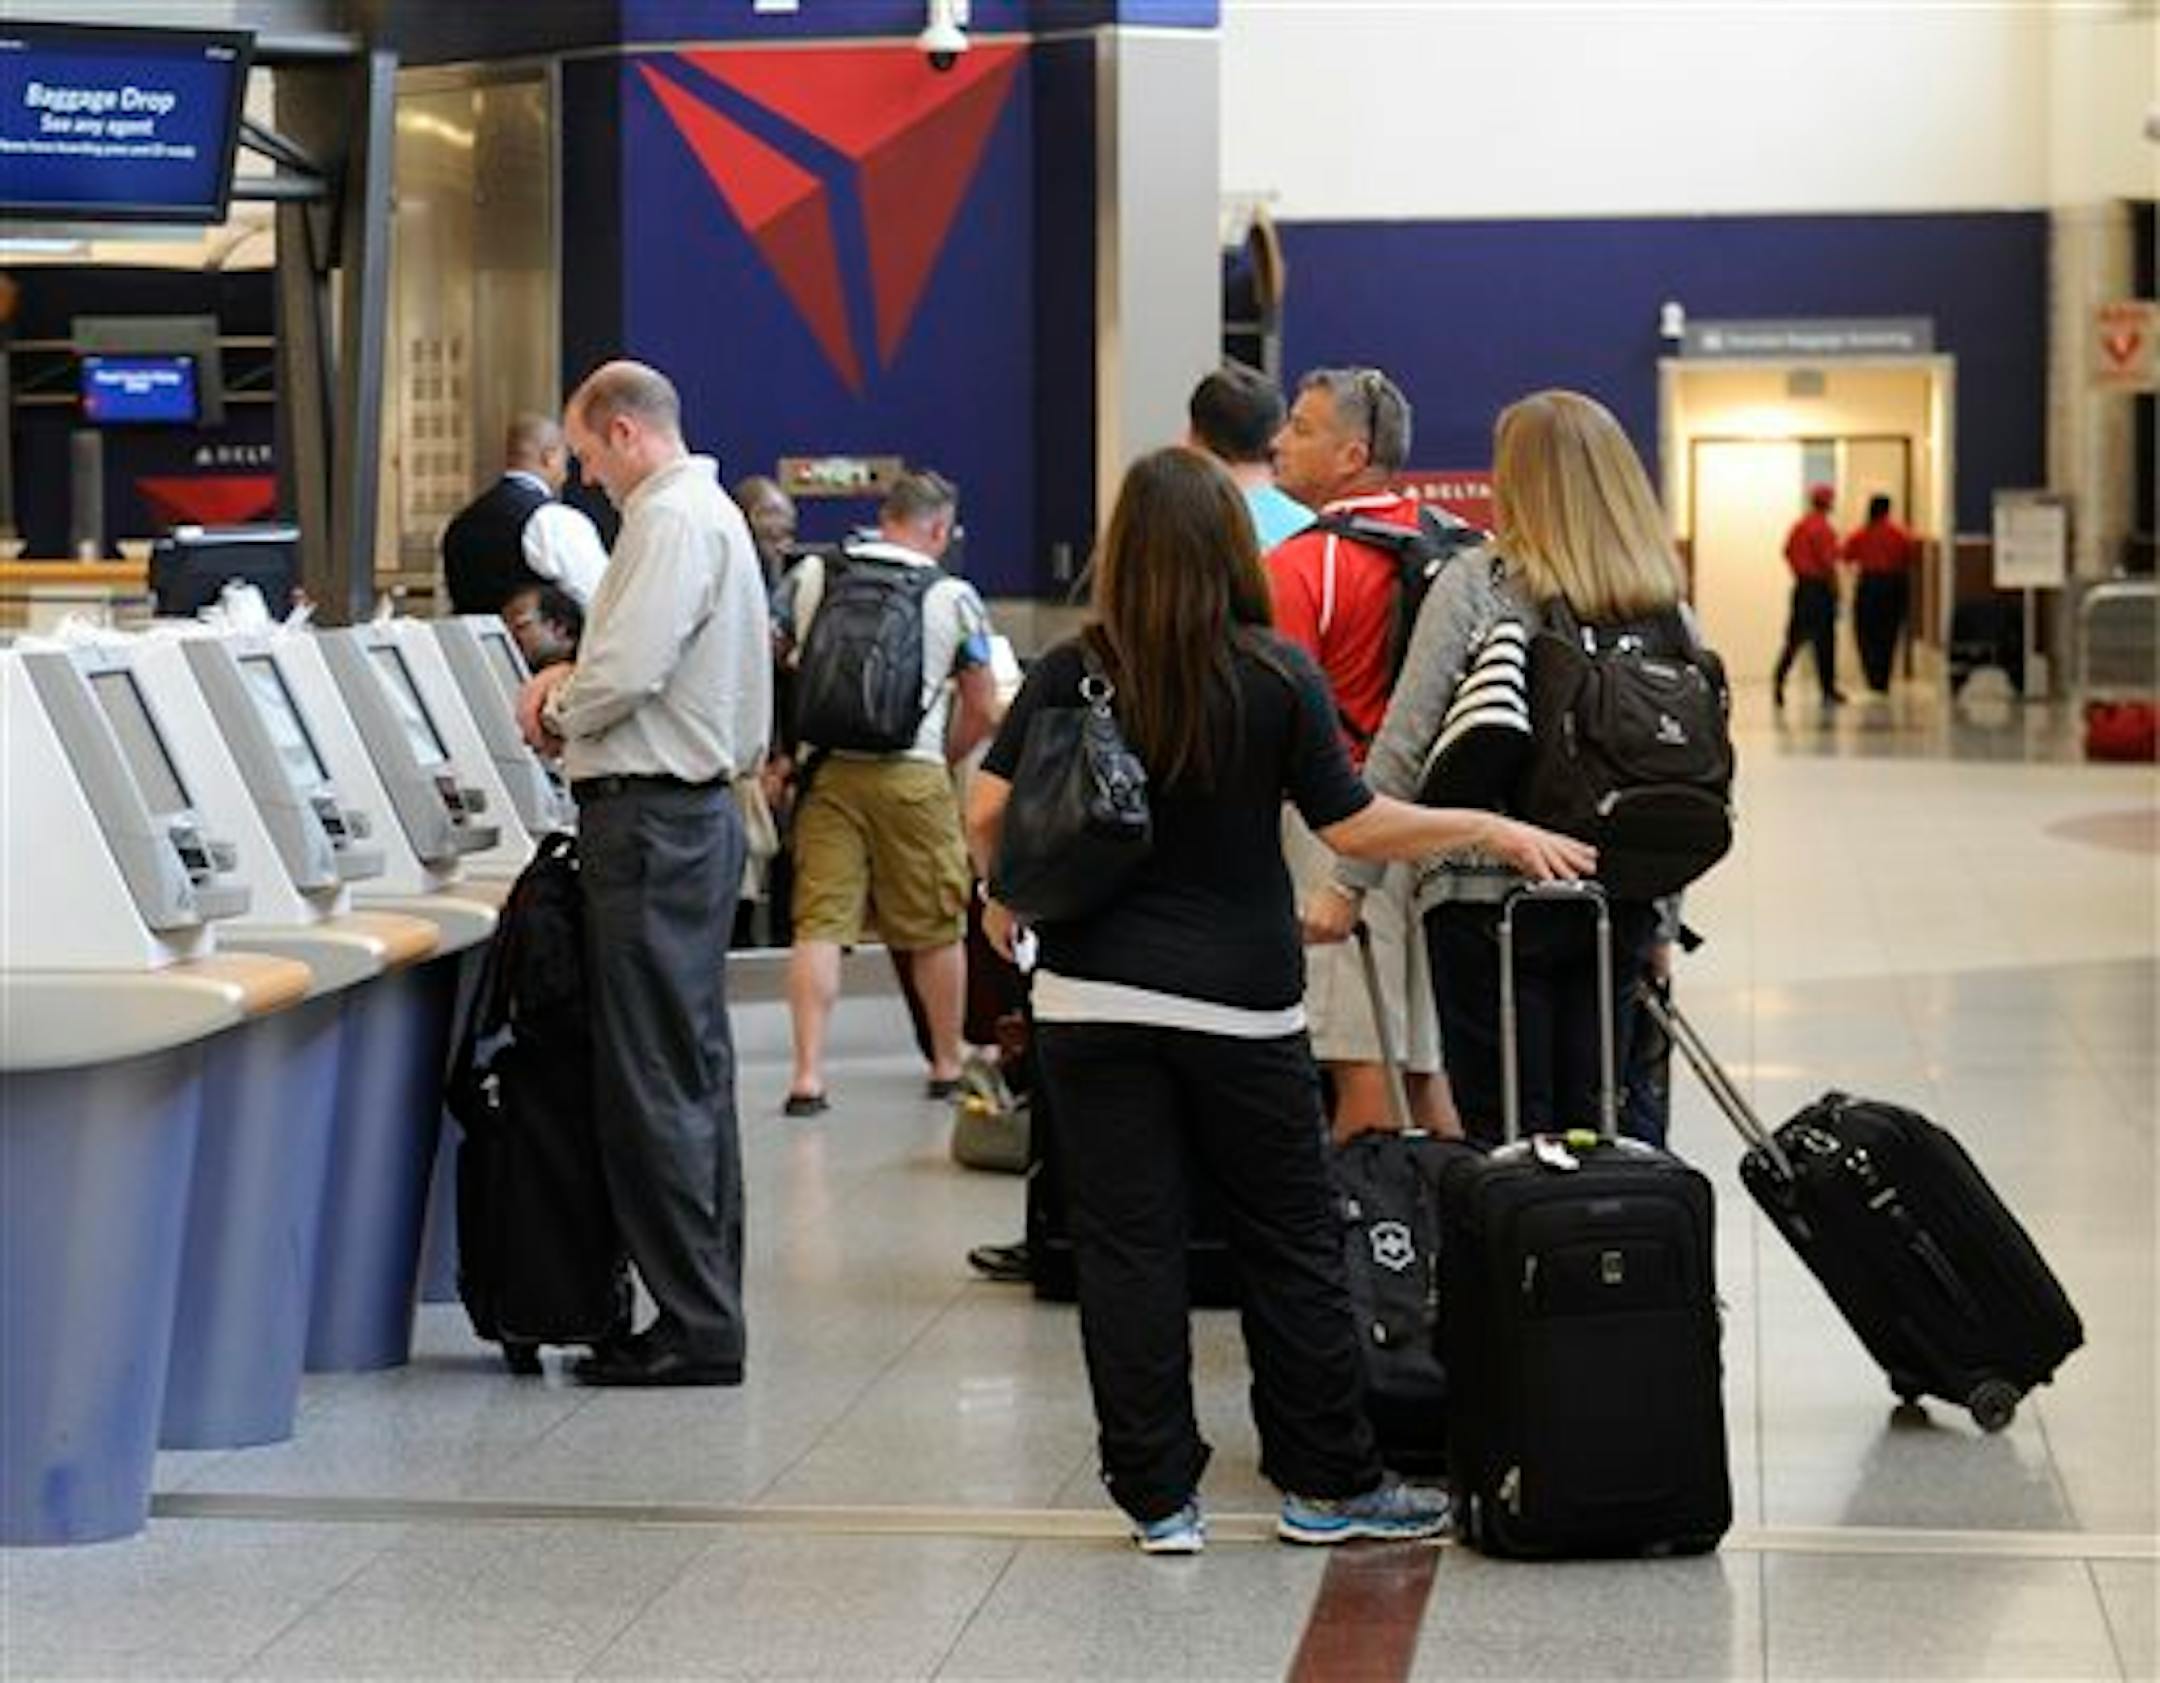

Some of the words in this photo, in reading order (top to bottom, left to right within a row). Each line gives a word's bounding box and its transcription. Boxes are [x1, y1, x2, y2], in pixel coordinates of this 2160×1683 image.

[25, 82, 118, 114] Baggage
[120, 86, 175, 116] Drop
[41, 113, 72, 133] See
[74, 118, 103, 137] any
[106, 118, 154, 138] agent
[216, 443, 273, 465] DELT
